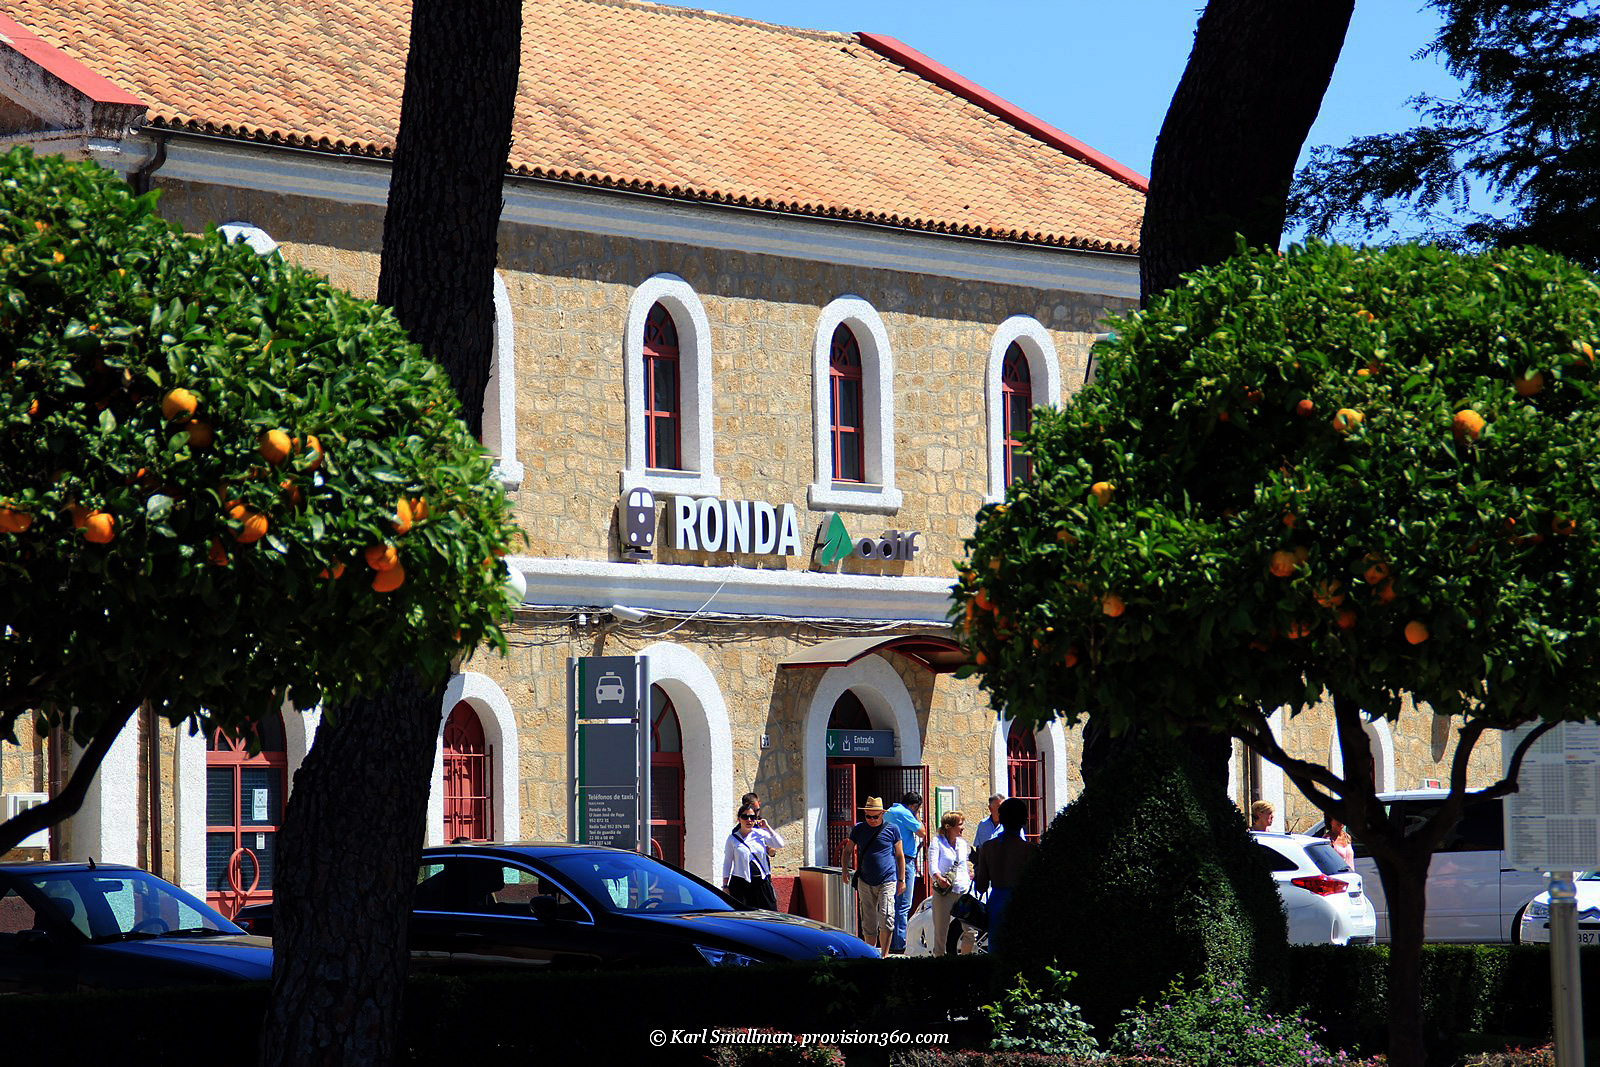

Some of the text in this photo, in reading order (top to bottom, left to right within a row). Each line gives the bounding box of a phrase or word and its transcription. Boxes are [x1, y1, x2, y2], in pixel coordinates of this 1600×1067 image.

[674, 495, 802, 557] RONDA
[855, 529, 922, 562] adif
[853, 735, 875, 744] Entrada
